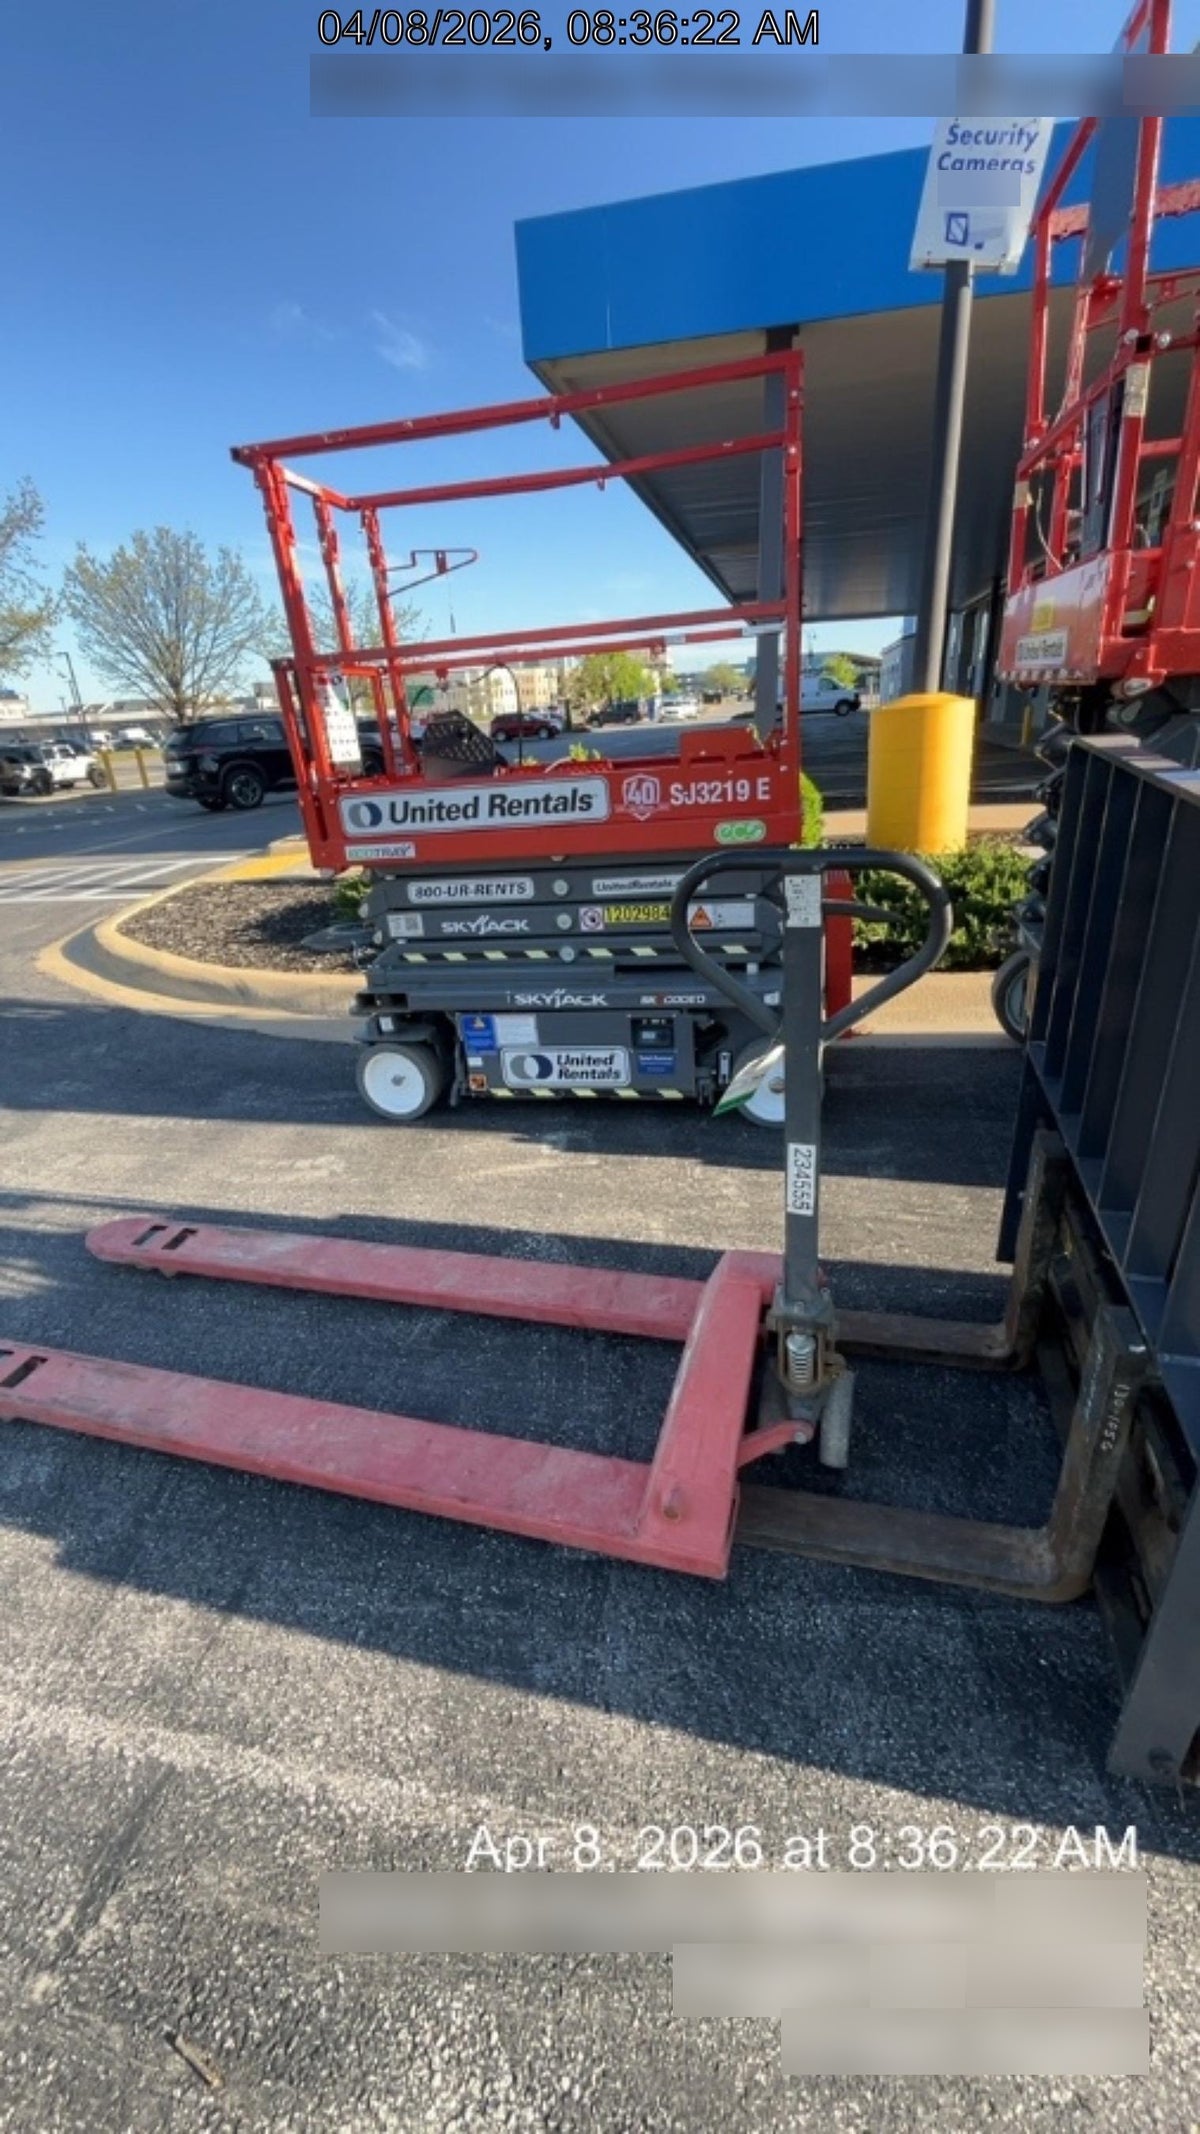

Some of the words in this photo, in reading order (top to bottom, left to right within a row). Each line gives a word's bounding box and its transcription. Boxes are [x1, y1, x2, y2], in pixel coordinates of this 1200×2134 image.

[946, 124, 1038, 152] Security
[937, 152, 1035, 174] Cameras
[628, 780, 656, 805] 40
[670, 779, 750, 806] SJ3219
[756, 777, 771, 800] E
[389, 796, 480, 824] United
[488, 787, 593, 819] Rentals
[414, 881, 528, 899] 800-UR-RENTS
[597, 878, 676, 892] UnitedRentals
[440, 915, 531, 935] SKYJACK
[513, 988, 609, 1008] SKYJACK
[557, 1053, 615, 1066] United
[558, 1067, 622, 1081] Rentals
